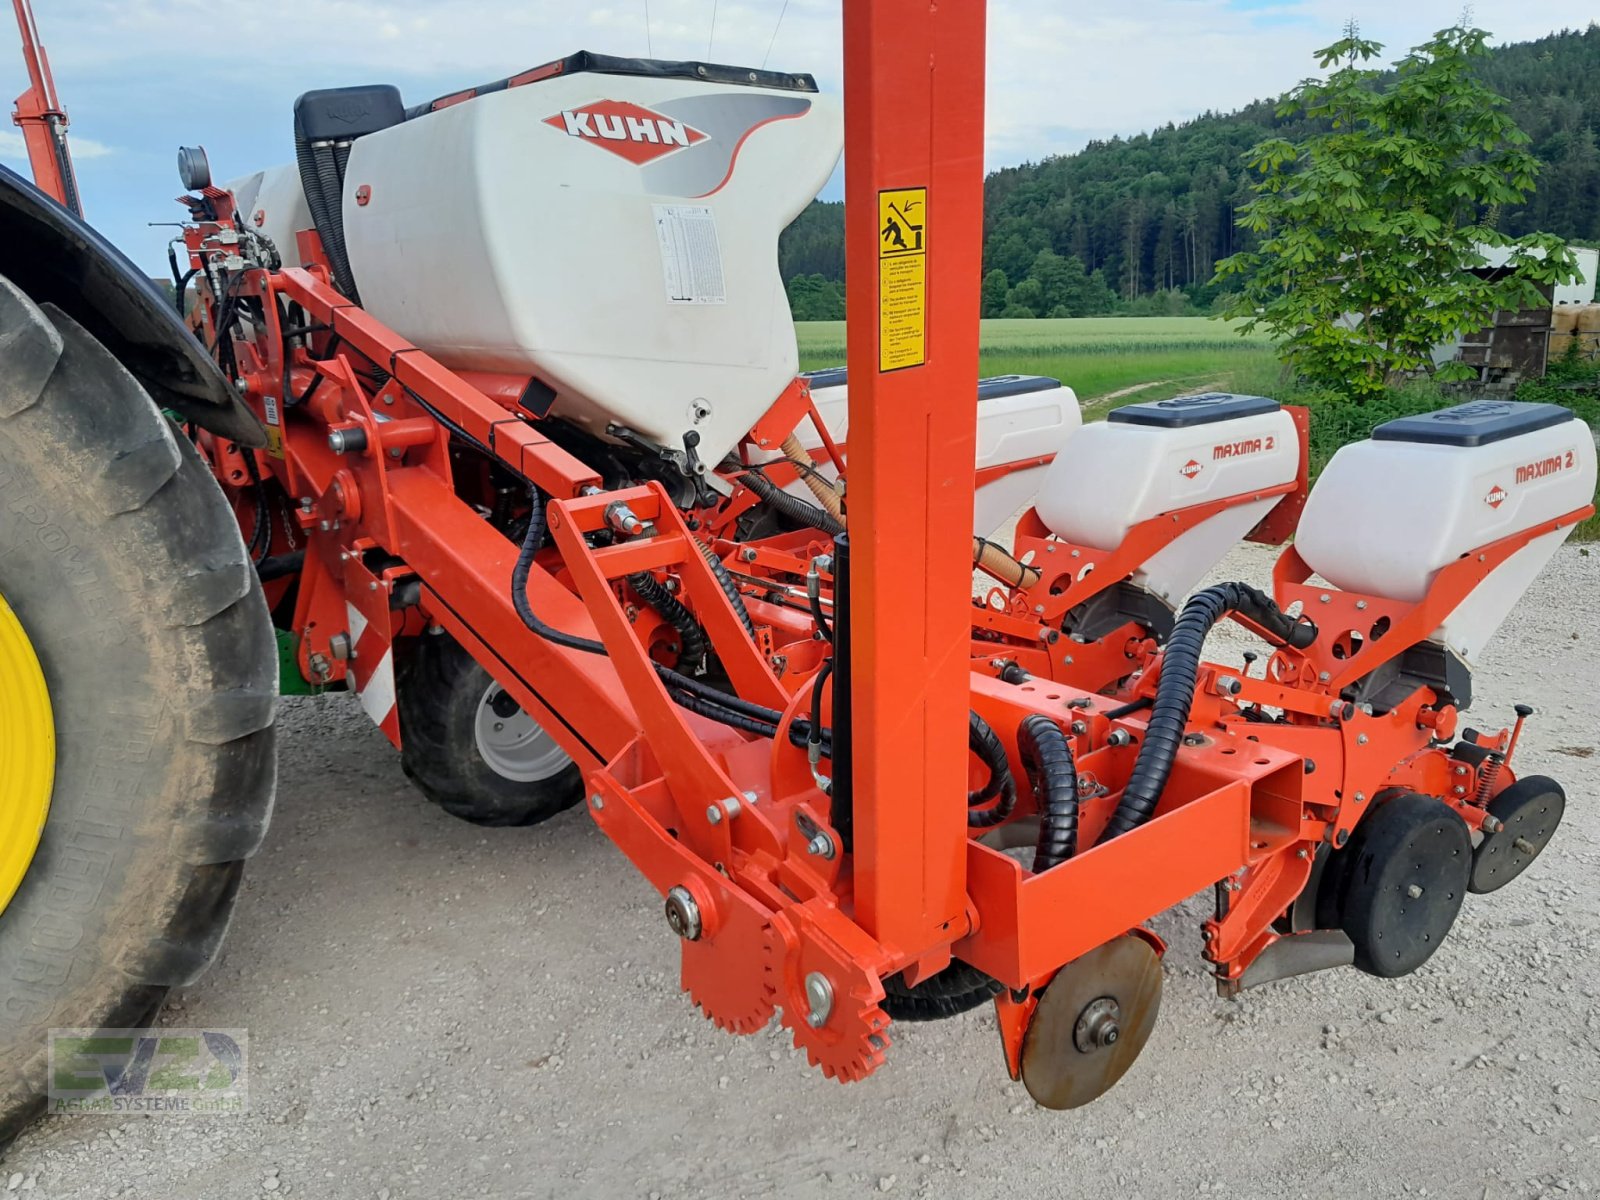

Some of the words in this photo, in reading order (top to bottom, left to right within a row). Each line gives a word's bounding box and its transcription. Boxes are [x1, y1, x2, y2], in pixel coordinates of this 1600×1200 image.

[560, 110, 691, 148] KUHN
[1212, 438, 1262, 461] MAXIMA
[1265, 436, 1275, 450] 2
[1181, 464, 1202, 475] KUHN
[1515, 455, 1562, 485] MAXIMA
[1565, 451, 1574, 469] 2
[1485, 489, 1506, 504] KUHN
[6, 697, 166, 1026] TRELLEBORG
